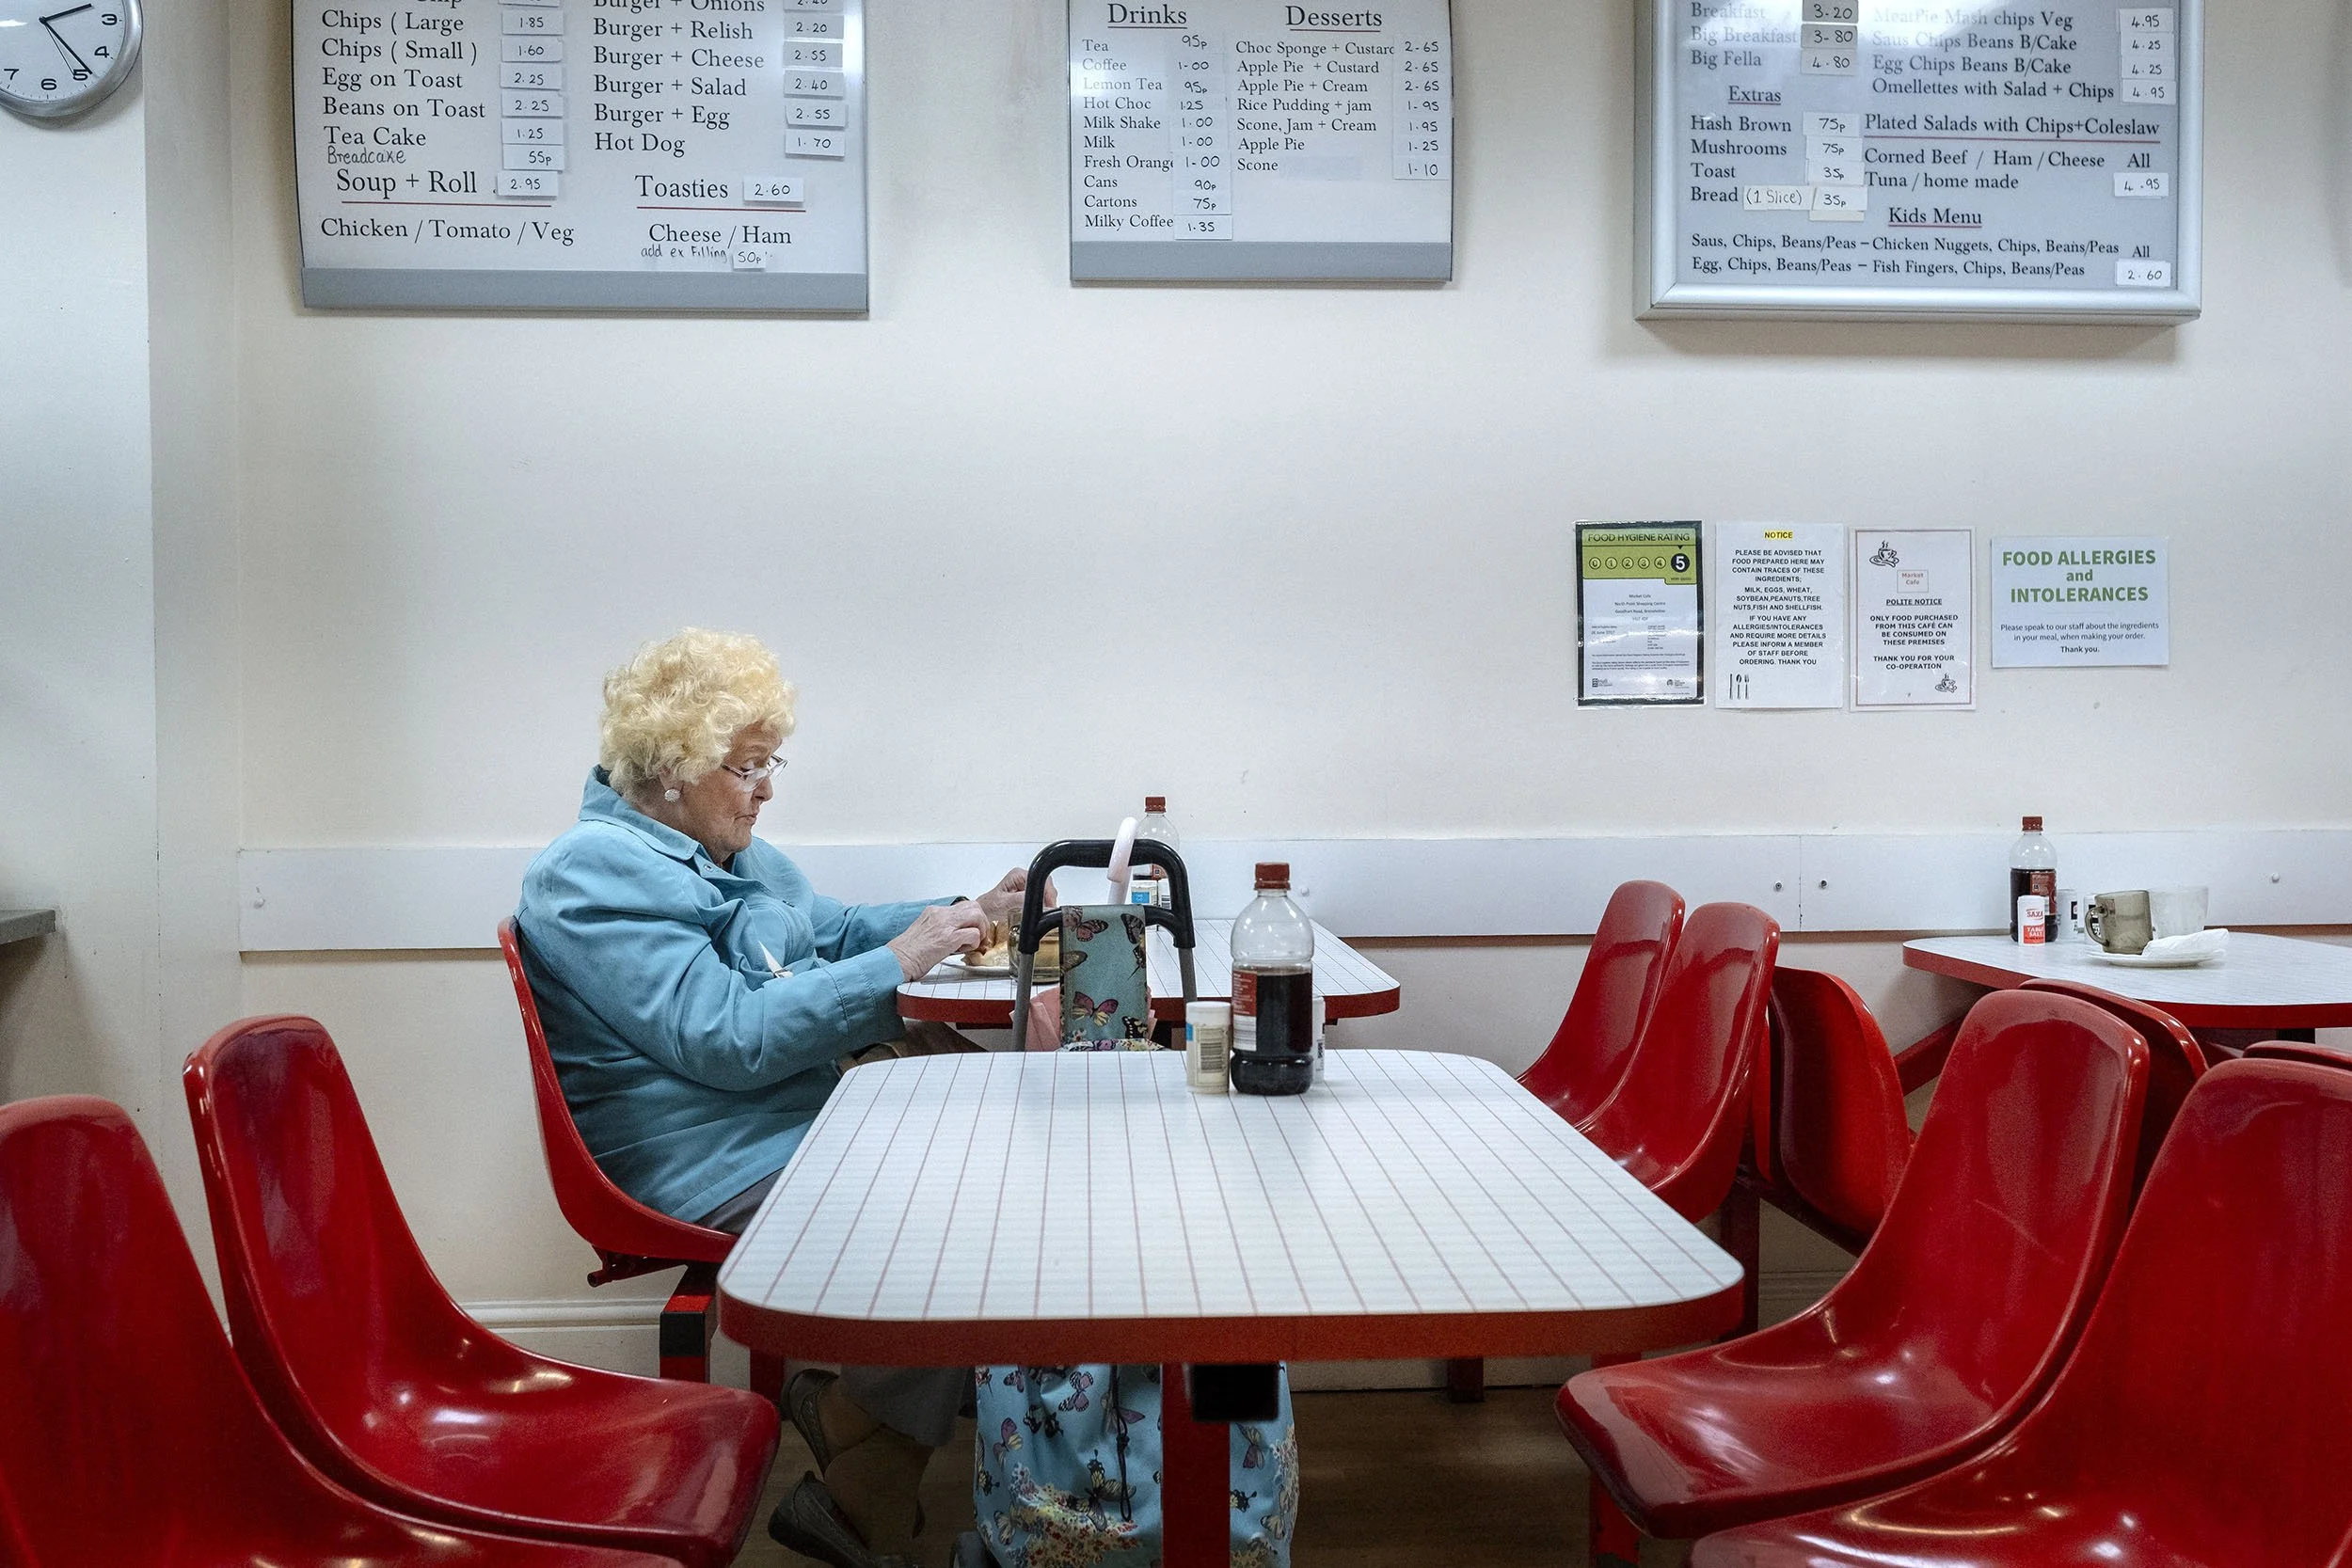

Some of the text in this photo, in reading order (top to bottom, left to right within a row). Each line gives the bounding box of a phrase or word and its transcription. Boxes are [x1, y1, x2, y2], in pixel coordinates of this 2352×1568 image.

[102, 14, 117, 25] 3
[1107, 4, 1186, 24] Drinks
[1286, 6, 1382, 26] Desserts
[594, 18, 753, 41] Burger + Relish
[1082, 40, 1108, 51] Tea
[1182, 35, 1207, 49] 95p
[94, 46, 109, 57] 4
[1692, 50, 1761, 70] Big Fella
[4, 69, 19, 80] 7
[73, 70, 88, 81] 5
[323, 67, 462, 91] Egg on Toast
[41, 79, 56, 90] 6
[1873, 78, 2113, 103] Omellettes with Salad + Chips
[1729, 86, 1781, 102] Extras
[323, 97, 485, 118] Beans on Toast
[1084, 97, 1151, 109] Hot Choc
[1238, 98, 1267, 110] Rice
[1273, 99, 1329, 115] Pudding
[1345, 101, 1371, 115] jam
[1084, 117, 1160, 129] Milk Shake
[1692, 116, 1791, 132] Hash Brown
[1819, 119, 1845, 133] 75p
[1867, 114, 2159, 138] Plated Salads with Chips+Coleslaw
[324, 126, 425, 146] Tea Cake
[1085, 135, 1115, 148] Milk
[595, 133, 685, 157] Hot Dog
[1239, 137, 1304, 154] Apple Pie
[1692, 139, 1787, 155] Mushrooms
[1822, 143, 1844, 155] 75p
[1238, 158, 1278, 170] Scone
[1691, 163, 1735, 178] Toast
[1085, 175, 1117, 187] Cans
[1824, 167, 1844, 180] 35p
[338, 168, 476, 199] Soup + Roll
[635, 175, 727, 198] Toasties
[1195, 180, 1216, 190] 90p
[1085, 195, 1136, 207] Cartons
[1692, 186, 1738, 201] Bread
[1823, 194, 1846, 207] 35p
[1193, 198, 1216, 210] 75p
[1086, 214, 1173, 229] Milky Coffee
[1889, 208, 1981, 224] Kids Menu
[322, 218, 407, 236] Chicken
[429, 220, 510, 238] Tomato
[532, 222, 574, 246] Veg
[649, 224, 721, 242] Cheese
[742, 226, 791, 244] Ham
[642, 244, 662, 257] add
[1676, 556, 1685, 570] 5
[2003, 549, 2155, 565] FOOD ALLERGIES
[2066, 569, 2092, 581] and
[2011, 587, 2148, 602] INTOLERANCES
[2025, 624, 2044, 632] speak
[2121, 622, 2159, 630] ingredients
